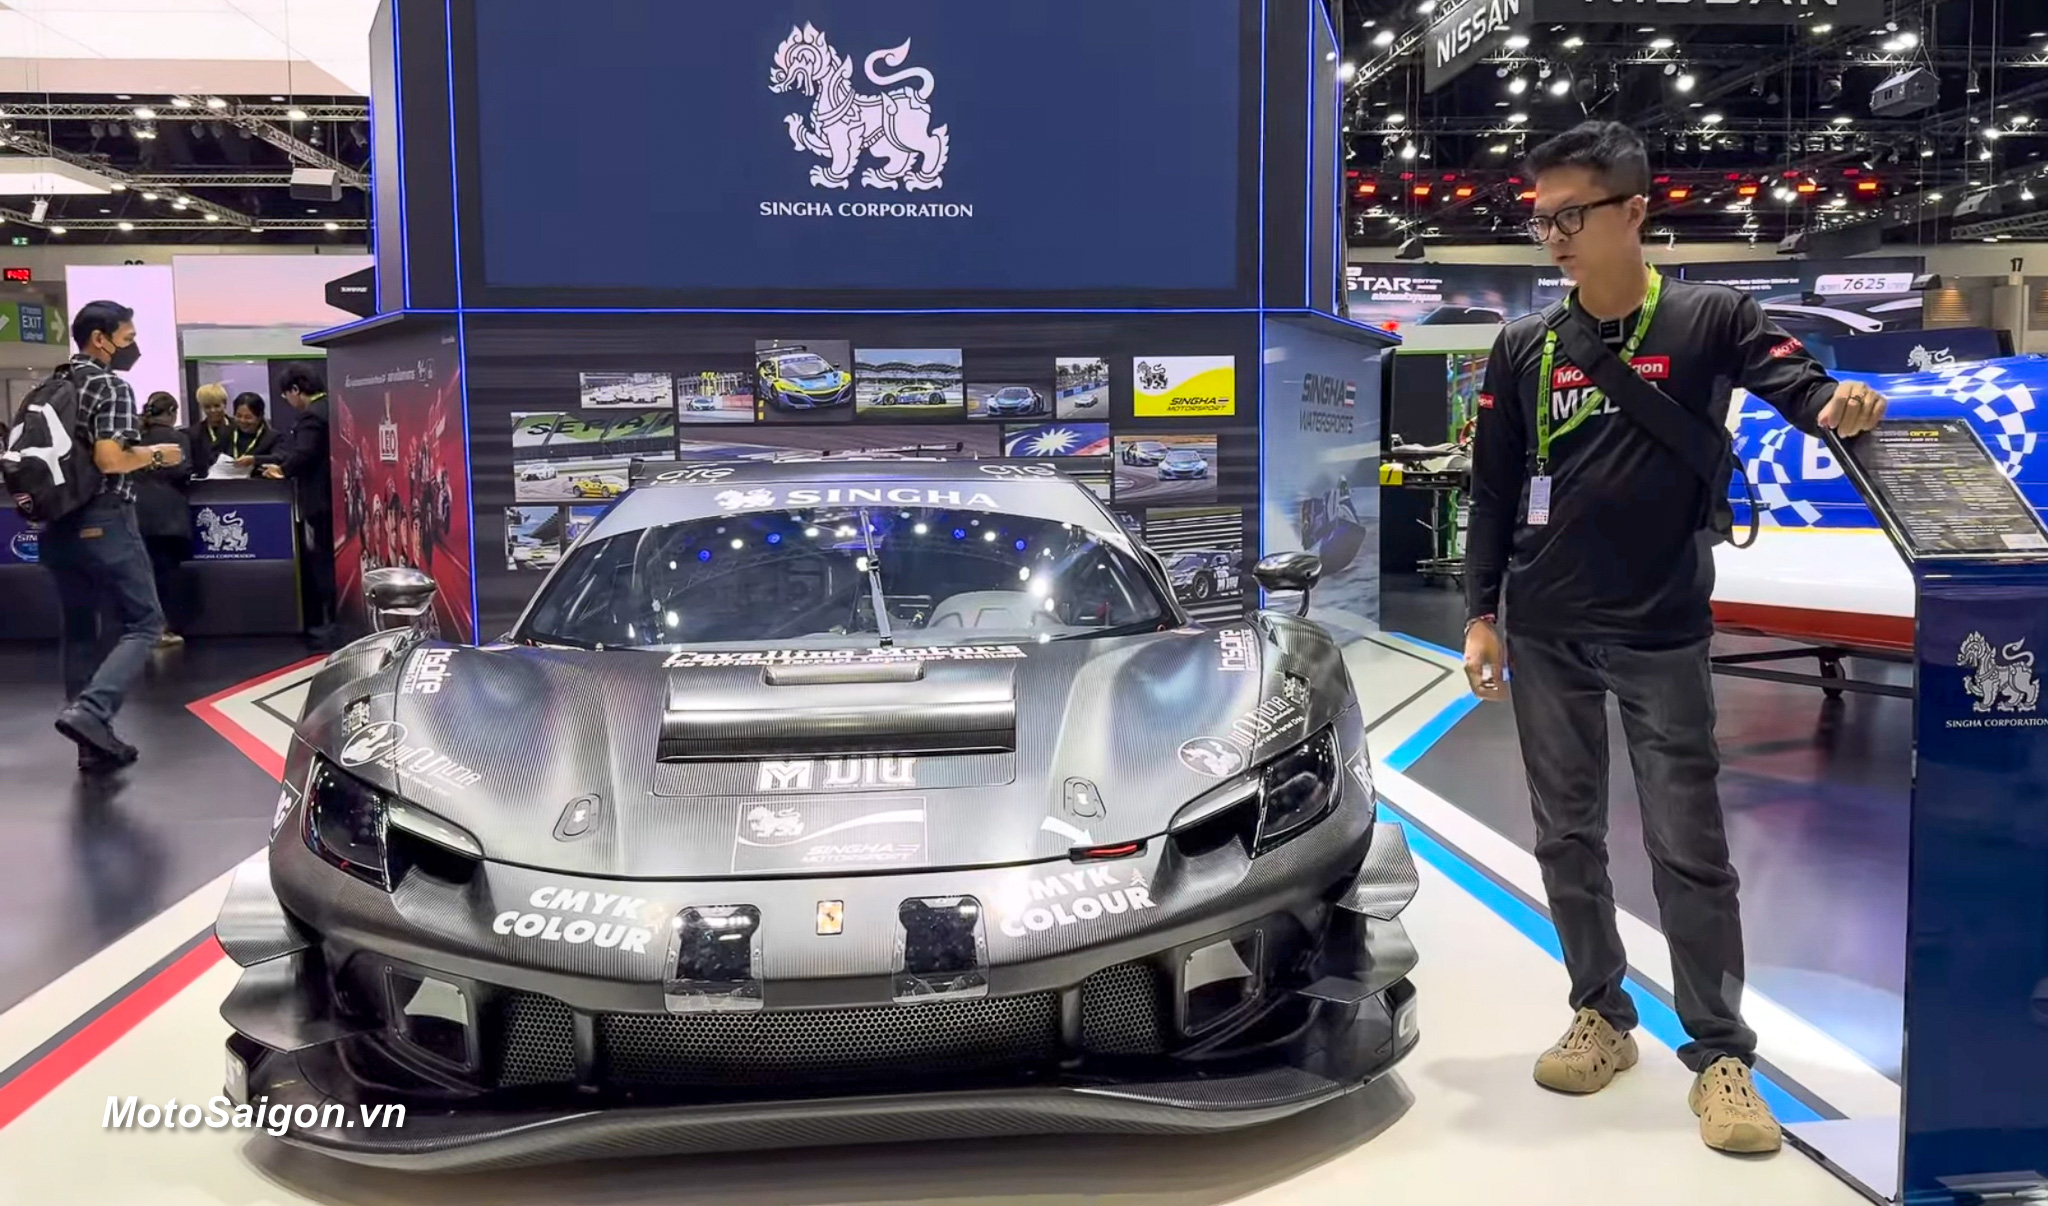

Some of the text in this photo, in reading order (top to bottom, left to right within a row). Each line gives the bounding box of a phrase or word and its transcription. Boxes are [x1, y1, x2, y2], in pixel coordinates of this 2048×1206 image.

[1437, 0, 1519, 68] NISSAN
[759, 201, 973, 217] SINGHA CORPORATION
[2010, 257, 2023, 272] 17
[22, 316, 42, 328] EXIT
[1301, 373, 1346, 407] SINGHA
[1169, 397, 1217, 406] SINGHA
[1300, 410, 1354, 434] WATERSPORTS
[785, 488, 999, 508] SINGHA
[1945, 720, 1982, 728] SINGHA
[806, 844, 893, 855] SINGHA
[529, 886, 647, 920] CMYK
[1001, 886, 1157, 938] COLOUR
[492, 910, 653, 955] COLOUR
